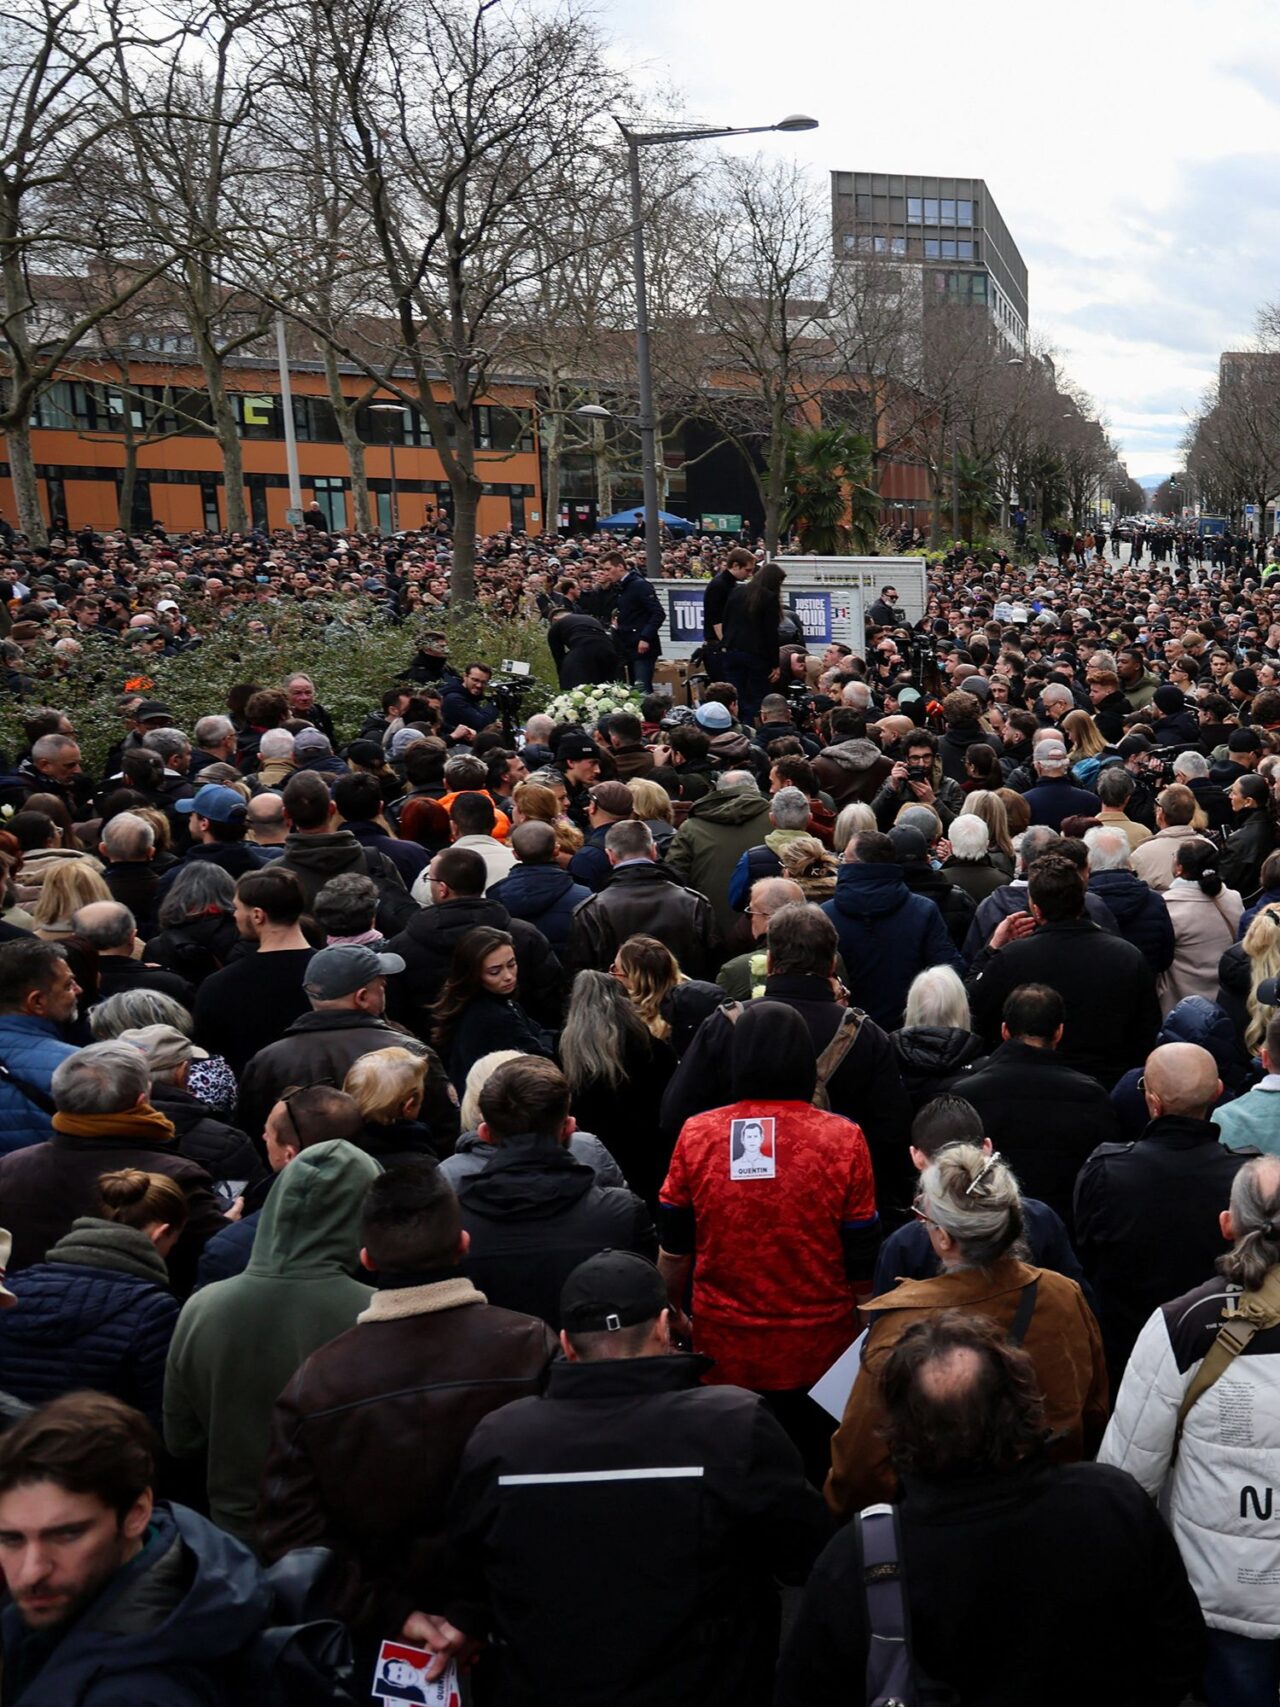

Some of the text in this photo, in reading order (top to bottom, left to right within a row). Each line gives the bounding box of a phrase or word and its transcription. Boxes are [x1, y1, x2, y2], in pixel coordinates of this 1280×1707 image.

[795, 598, 825, 609] JUSTICE
[796, 609, 826, 625] POUR
[1240, 1485, 1273, 1521] N
